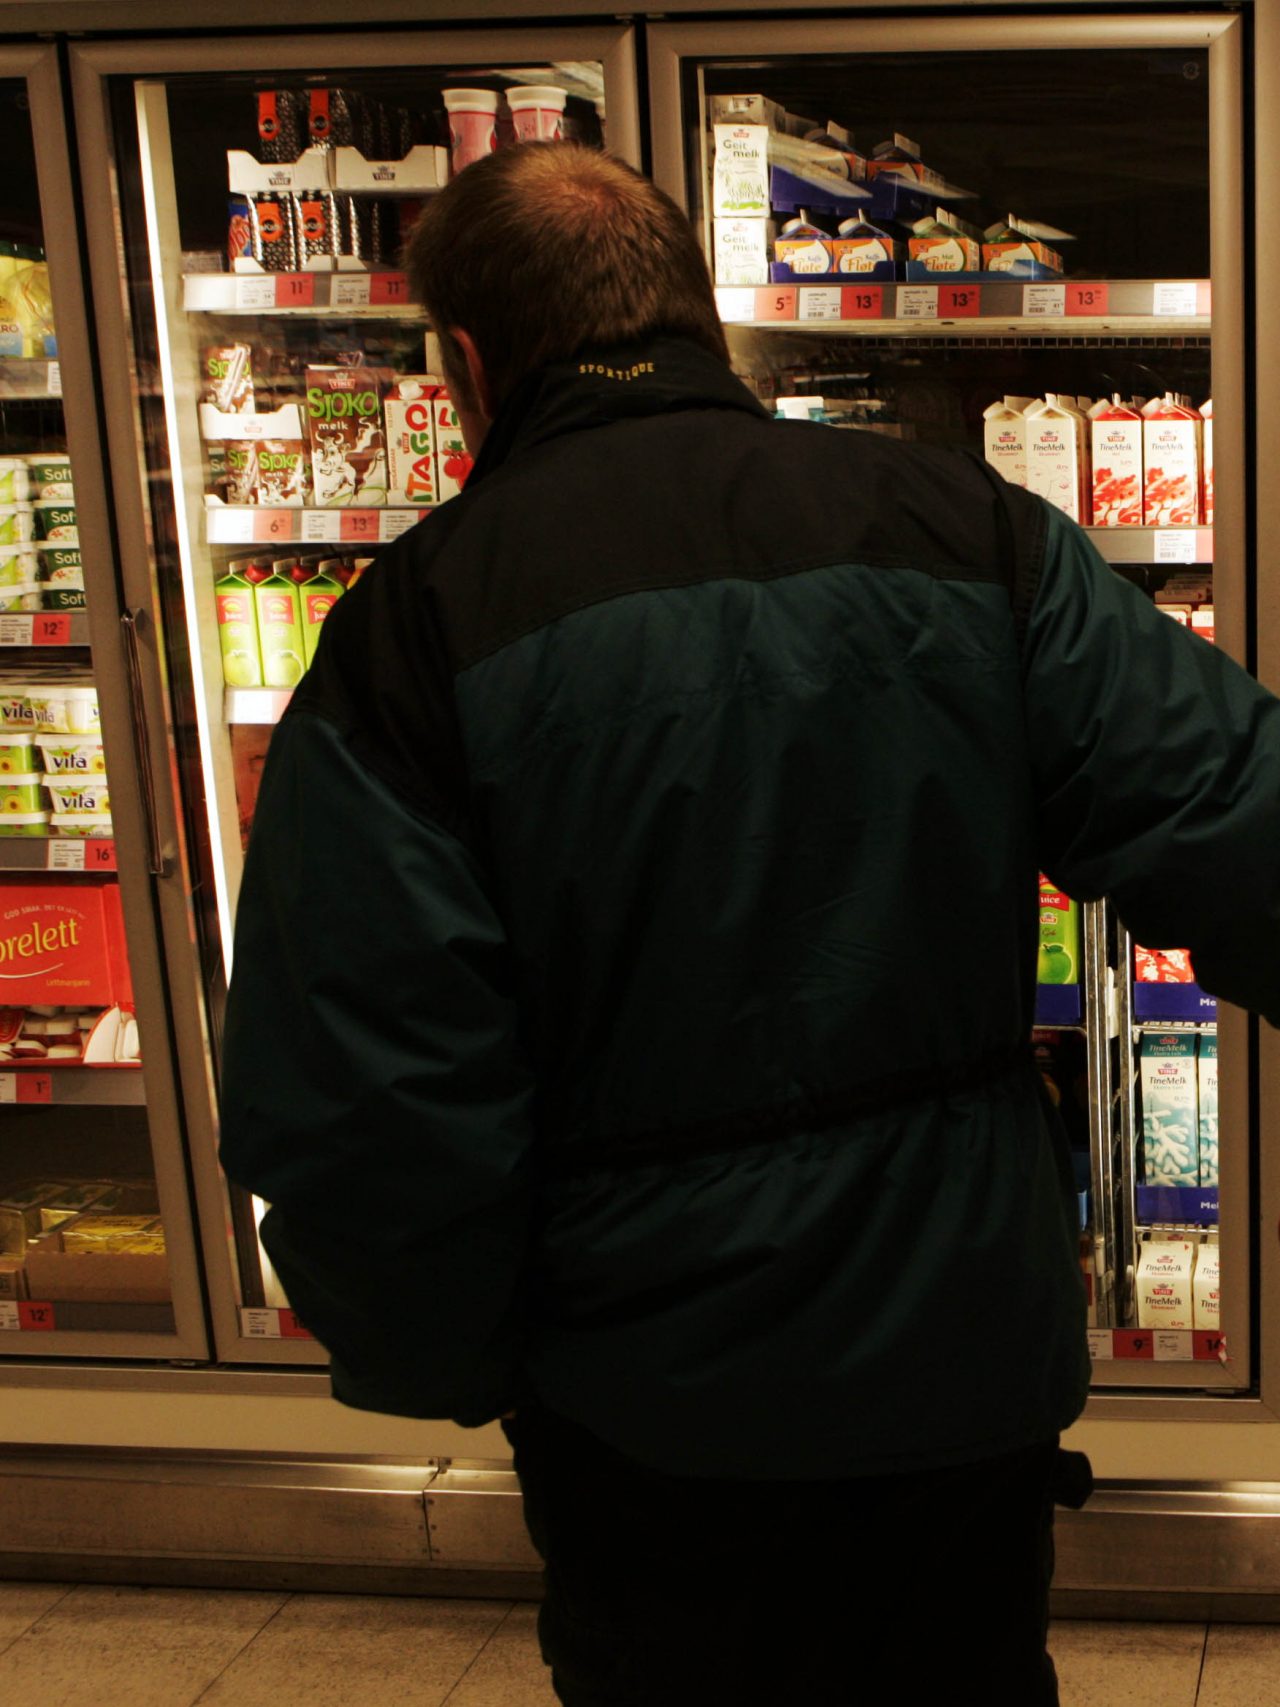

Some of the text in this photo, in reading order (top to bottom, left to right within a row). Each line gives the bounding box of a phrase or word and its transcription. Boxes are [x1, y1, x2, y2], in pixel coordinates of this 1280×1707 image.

[723, 139, 747, 150] Geit
[847, 258, 876, 273] Fløt
[775, 296, 785, 311] 5
[856, 296, 873, 310] 13
[951, 293, 968, 307] 13
[1078, 291, 1094, 305] 13
[318, 420, 349, 431] melk
[992, 443, 1023, 452] TineMelk
[1033, 443, 1066, 452] TineMelk
[1100, 443, 1133, 451] TineMelk
[1151, 442, 1184, 451] TineMelk
[404, 404, 434, 502] ITAGO
[53, 753, 88, 769] vita
[61, 793, 96, 809] vita
[1149, 1076, 1188, 1085] TineMelk
[1145, 1263, 1183, 1273] TineMelk
[1145, 1296, 1183, 1306] TineMelk
